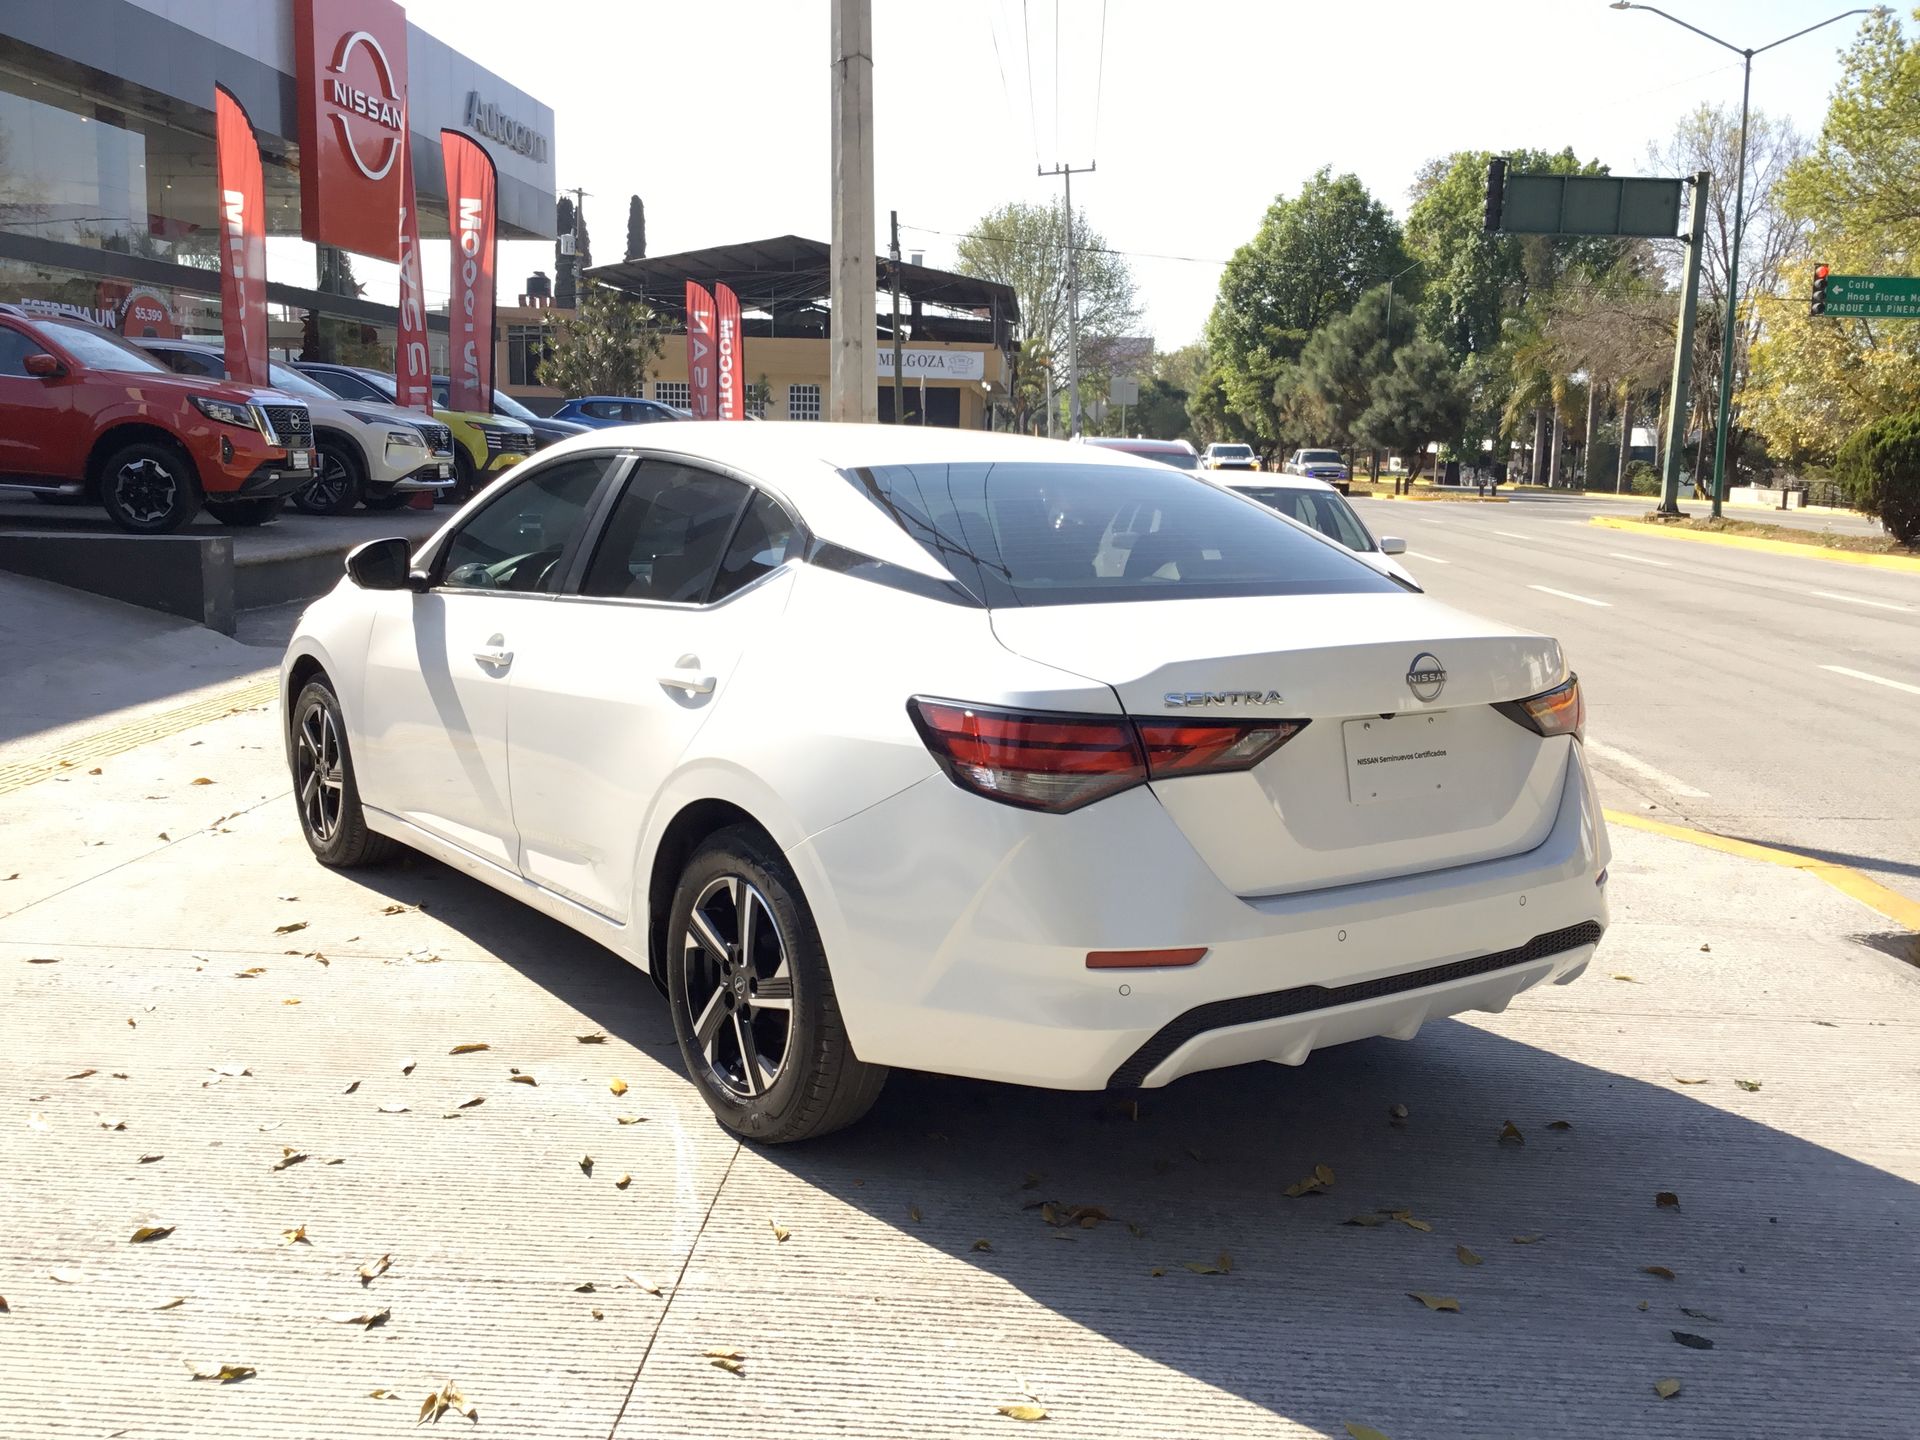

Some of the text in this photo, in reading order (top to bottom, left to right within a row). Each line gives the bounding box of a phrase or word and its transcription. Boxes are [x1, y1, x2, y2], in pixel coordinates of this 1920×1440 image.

[334, 79, 403, 130] NISSAN
[1848, 280, 1875, 289] Calle
[1847, 292, 1871, 301] Hnos
[1875, 292, 1906, 302] Flores
[135, 305, 163, 322] $5,399
[1826, 303, 1864, 313] PARQUE
[1869, 304, 1881, 313] LA
[95, 308, 116, 329] UN
[1408, 672, 1447, 683] NISSAN
[1164, 690, 1285, 708] SENTRA
[1356, 749, 1447, 766] NISSAN Seminuevos Certificados
